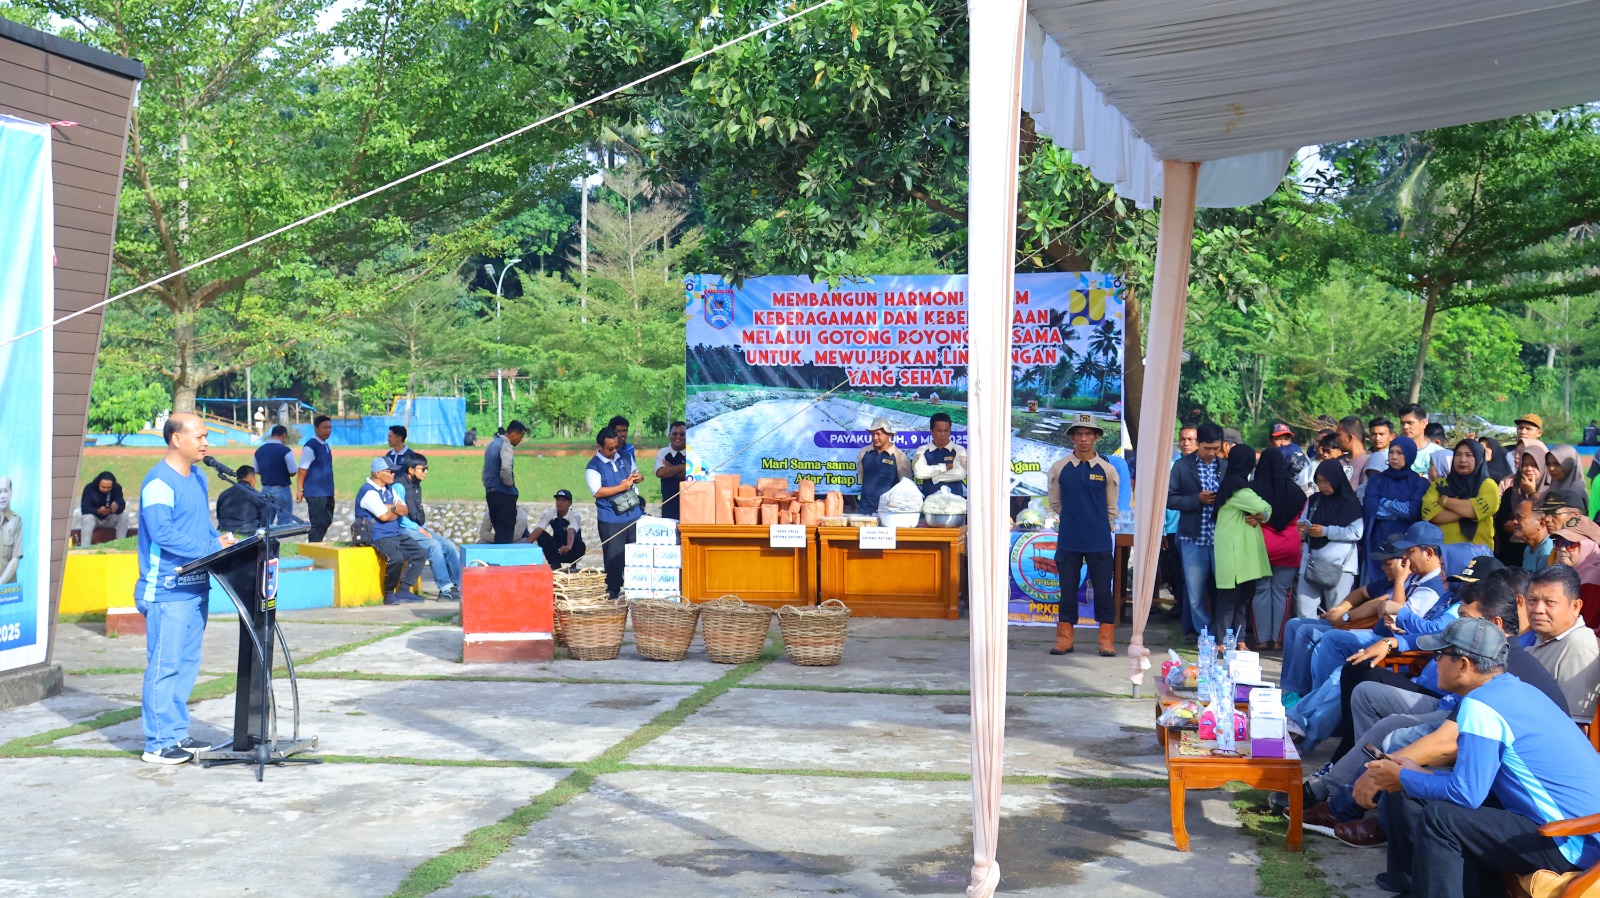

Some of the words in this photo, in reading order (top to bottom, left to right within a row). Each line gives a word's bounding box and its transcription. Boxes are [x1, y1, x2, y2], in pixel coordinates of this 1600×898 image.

[772, 292, 878, 307] MEMBANGUN
[884, 291, 964, 306] HARMONI
[754, 311, 877, 325] KEBERAGAMAN
[883, 311, 918, 325] DAN
[742, 330, 811, 345] MELALUI
[817, 330, 892, 345] GOTONG
[1012, 328, 1062, 344] SAMA
[746, 350, 802, 365] UNTUK
[814, 350, 937, 365] MEWUJUDKAN
[847, 370, 895, 385] YANG
[900, 370, 953, 385] SEHAT
[910, 434, 918, 444] 9
[761, 458, 789, 470] Mari
[790, 458, 857, 471] Sama-sama
[824, 473, 856, 488] Tetap
